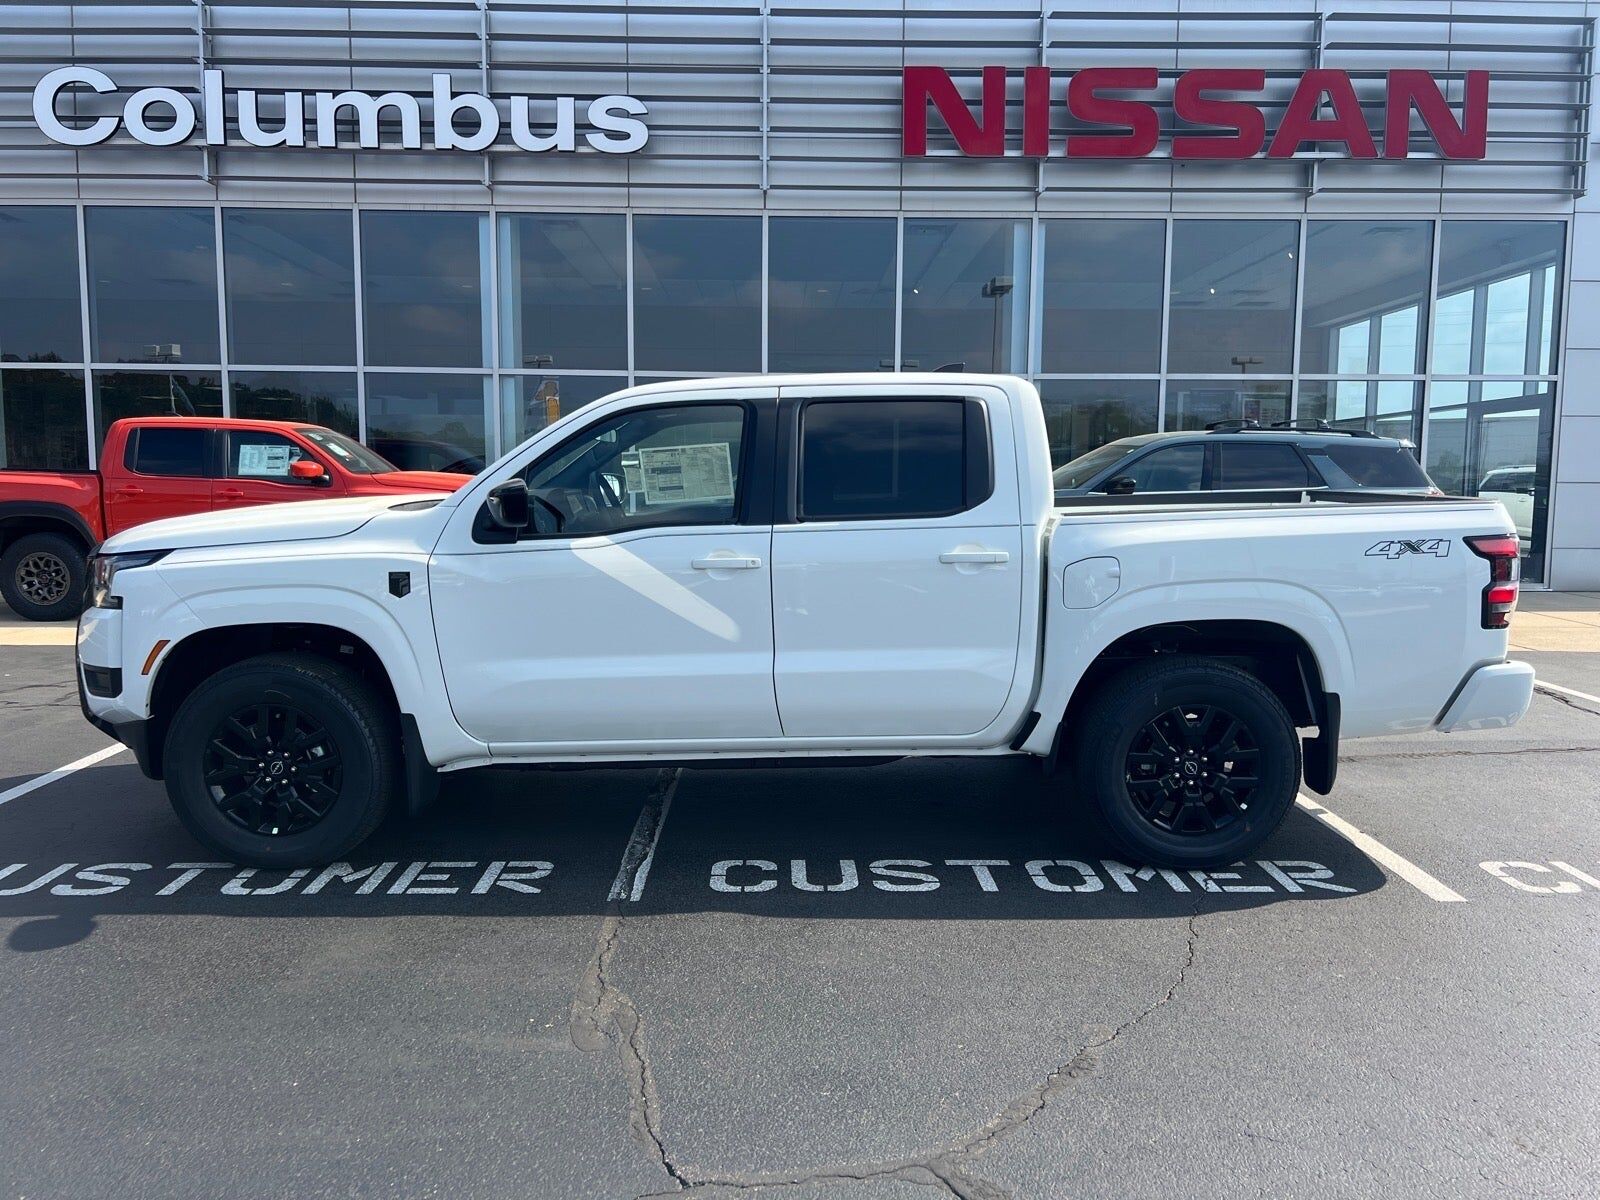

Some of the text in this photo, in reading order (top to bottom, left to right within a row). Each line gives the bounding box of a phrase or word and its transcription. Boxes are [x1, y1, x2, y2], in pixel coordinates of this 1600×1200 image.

[32, 65, 650, 155] Columbus
[902, 66, 1490, 160] NISSAN
[708, 859, 1358, 893] CUSTOMER
